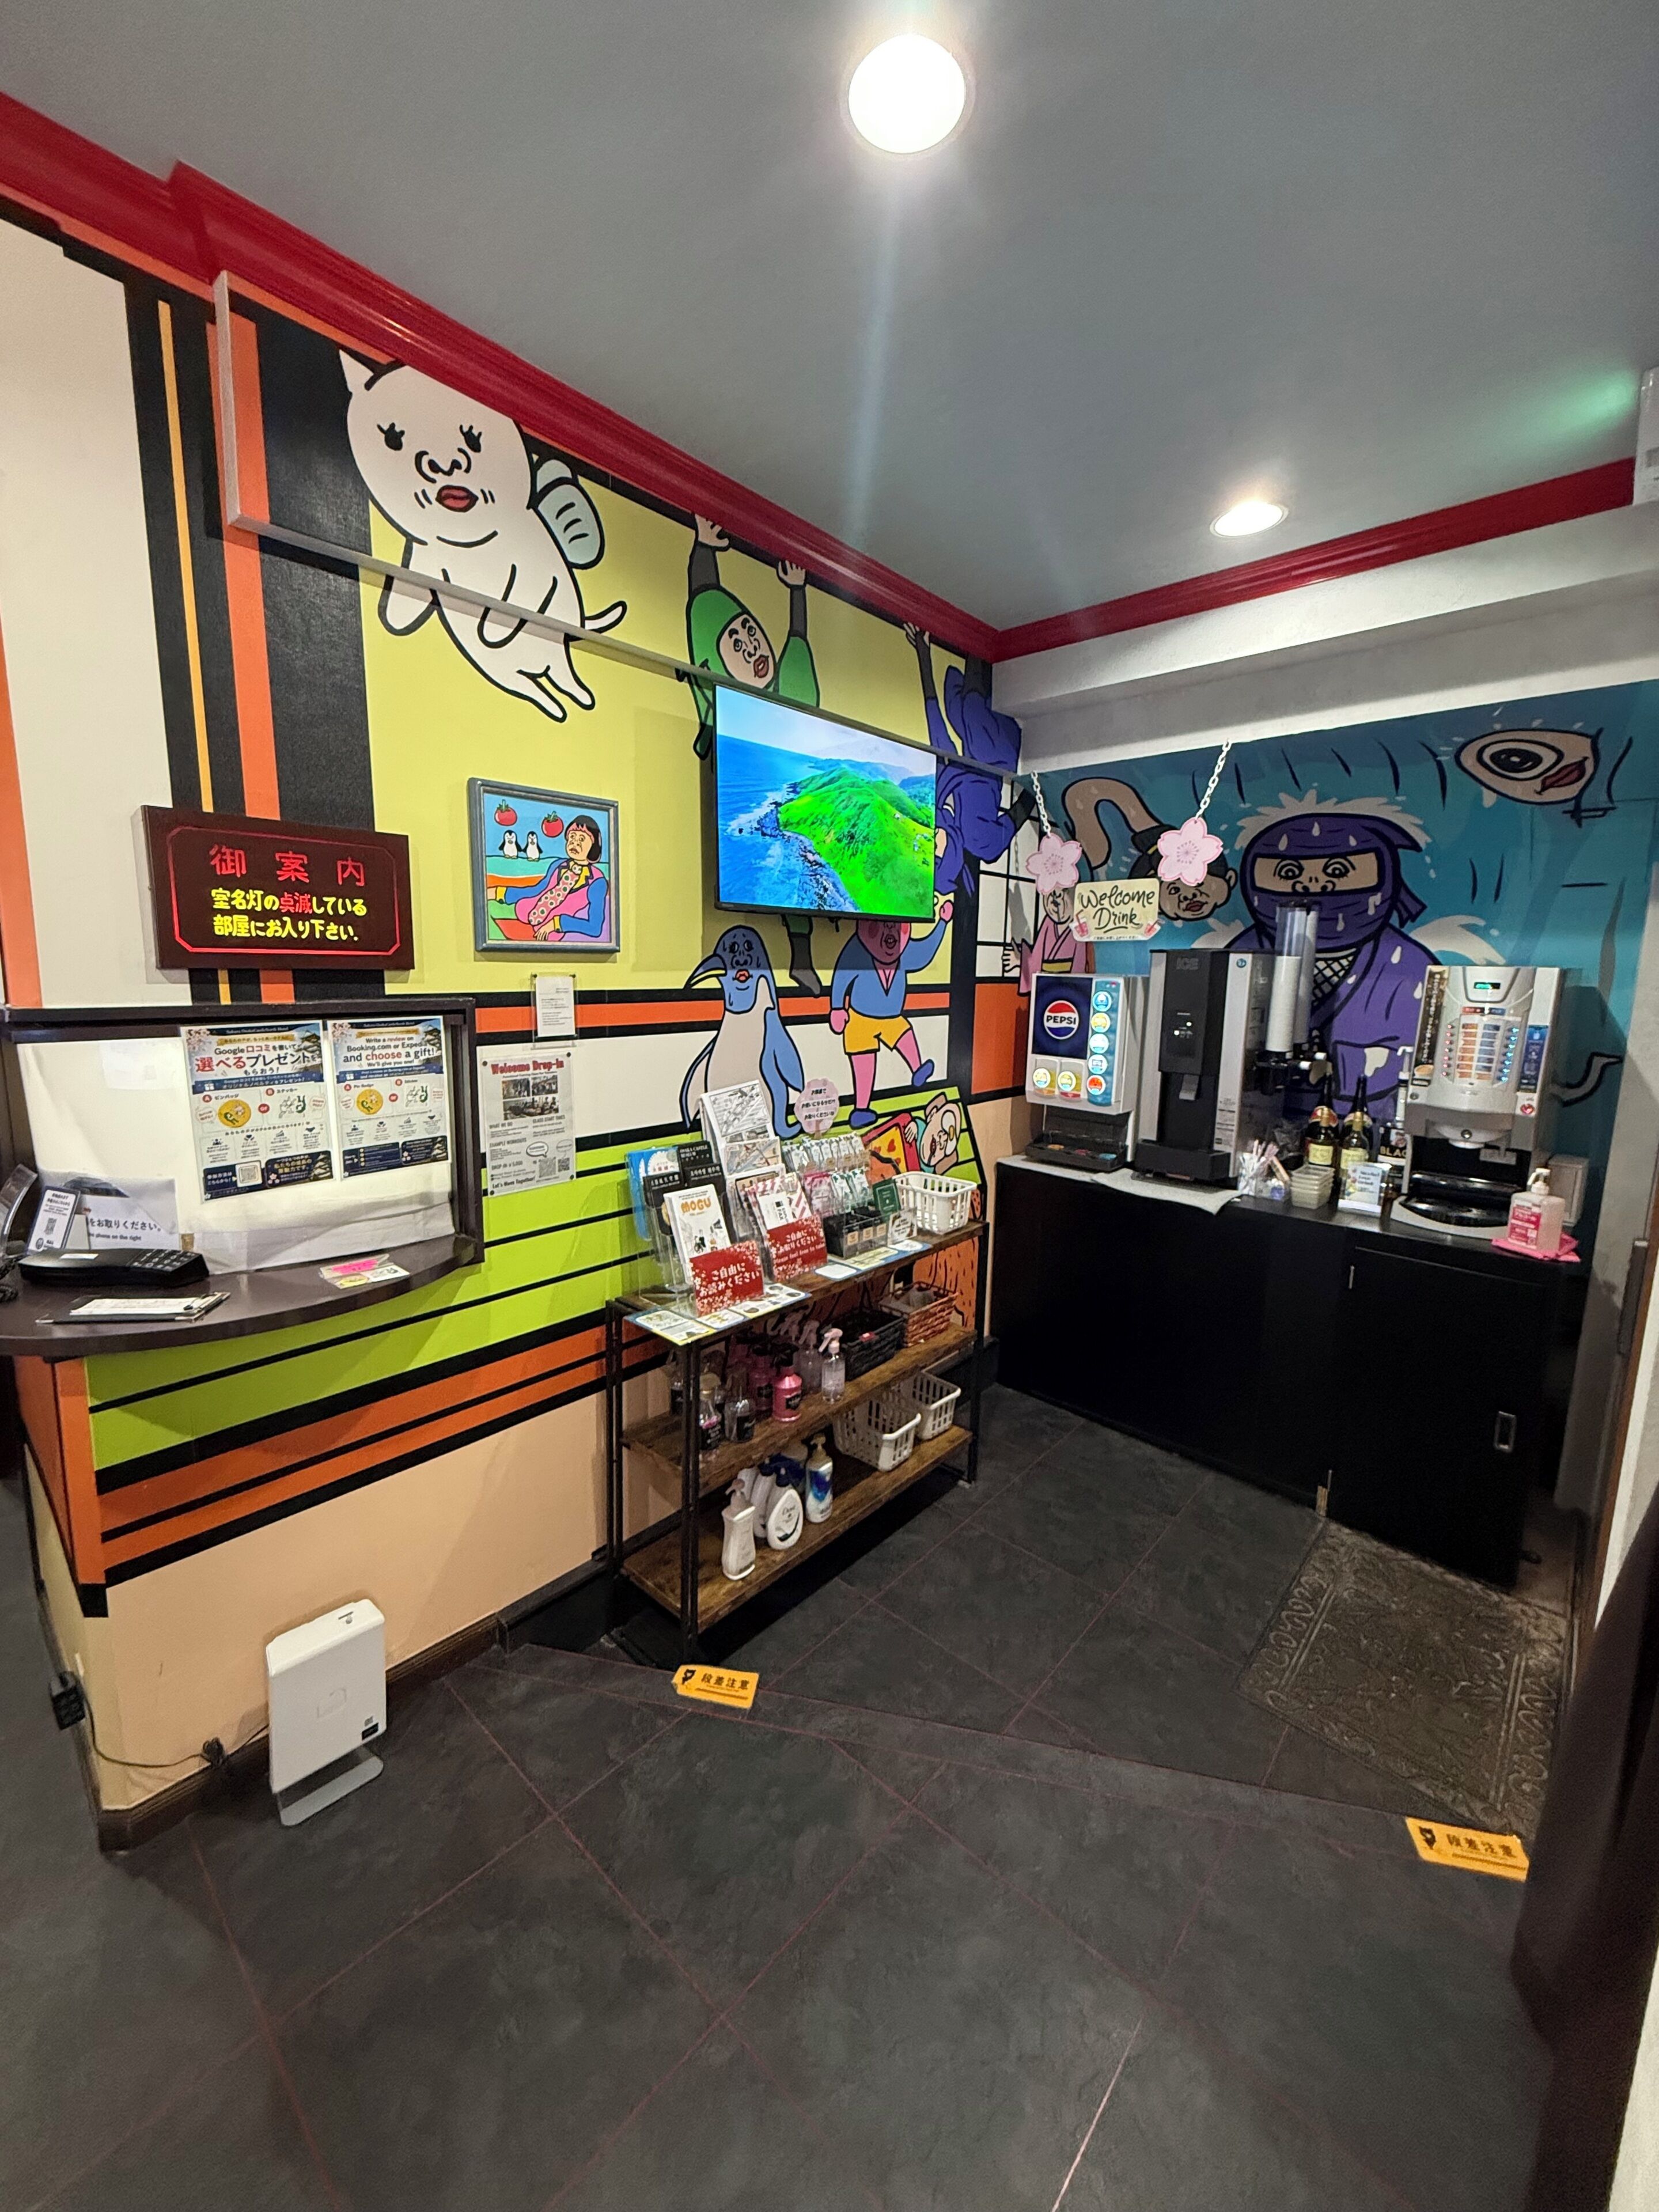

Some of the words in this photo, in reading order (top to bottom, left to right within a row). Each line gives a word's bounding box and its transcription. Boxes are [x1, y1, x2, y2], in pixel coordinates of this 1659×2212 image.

[209, 844, 366, 887] 御案内
[1081, 885, 1155, 908] Welcome
[1093, 907, 1141, 930] Drink
[1176, 957, 1199, 970] ICE
[1046, 1015, 1076, 1025] PEPSI
[214, 1047, 245, 1056] Google
[343, 1053, 362, 1063] and
[366, 1051, 402, 1061] choose
[414, 1047, 434, 1059] gift!
[347, 1044, 391, 1053] Booking.com
[195, 1052, 317, 1072] 選べるプレゼントを
[491, 1063, 530, 1074] Welcome
[532, 1058, 564, 1071] Drop-in
[681, 1196, 711, 1214] MOGU
[711, 1262, 745, 1281] ご自由に
[699, 1270, 760, 1297] お読みください
[701, 1673, 749, 1690] 段差注意
[1446, 1834, 1517, 1858] 段差注意
